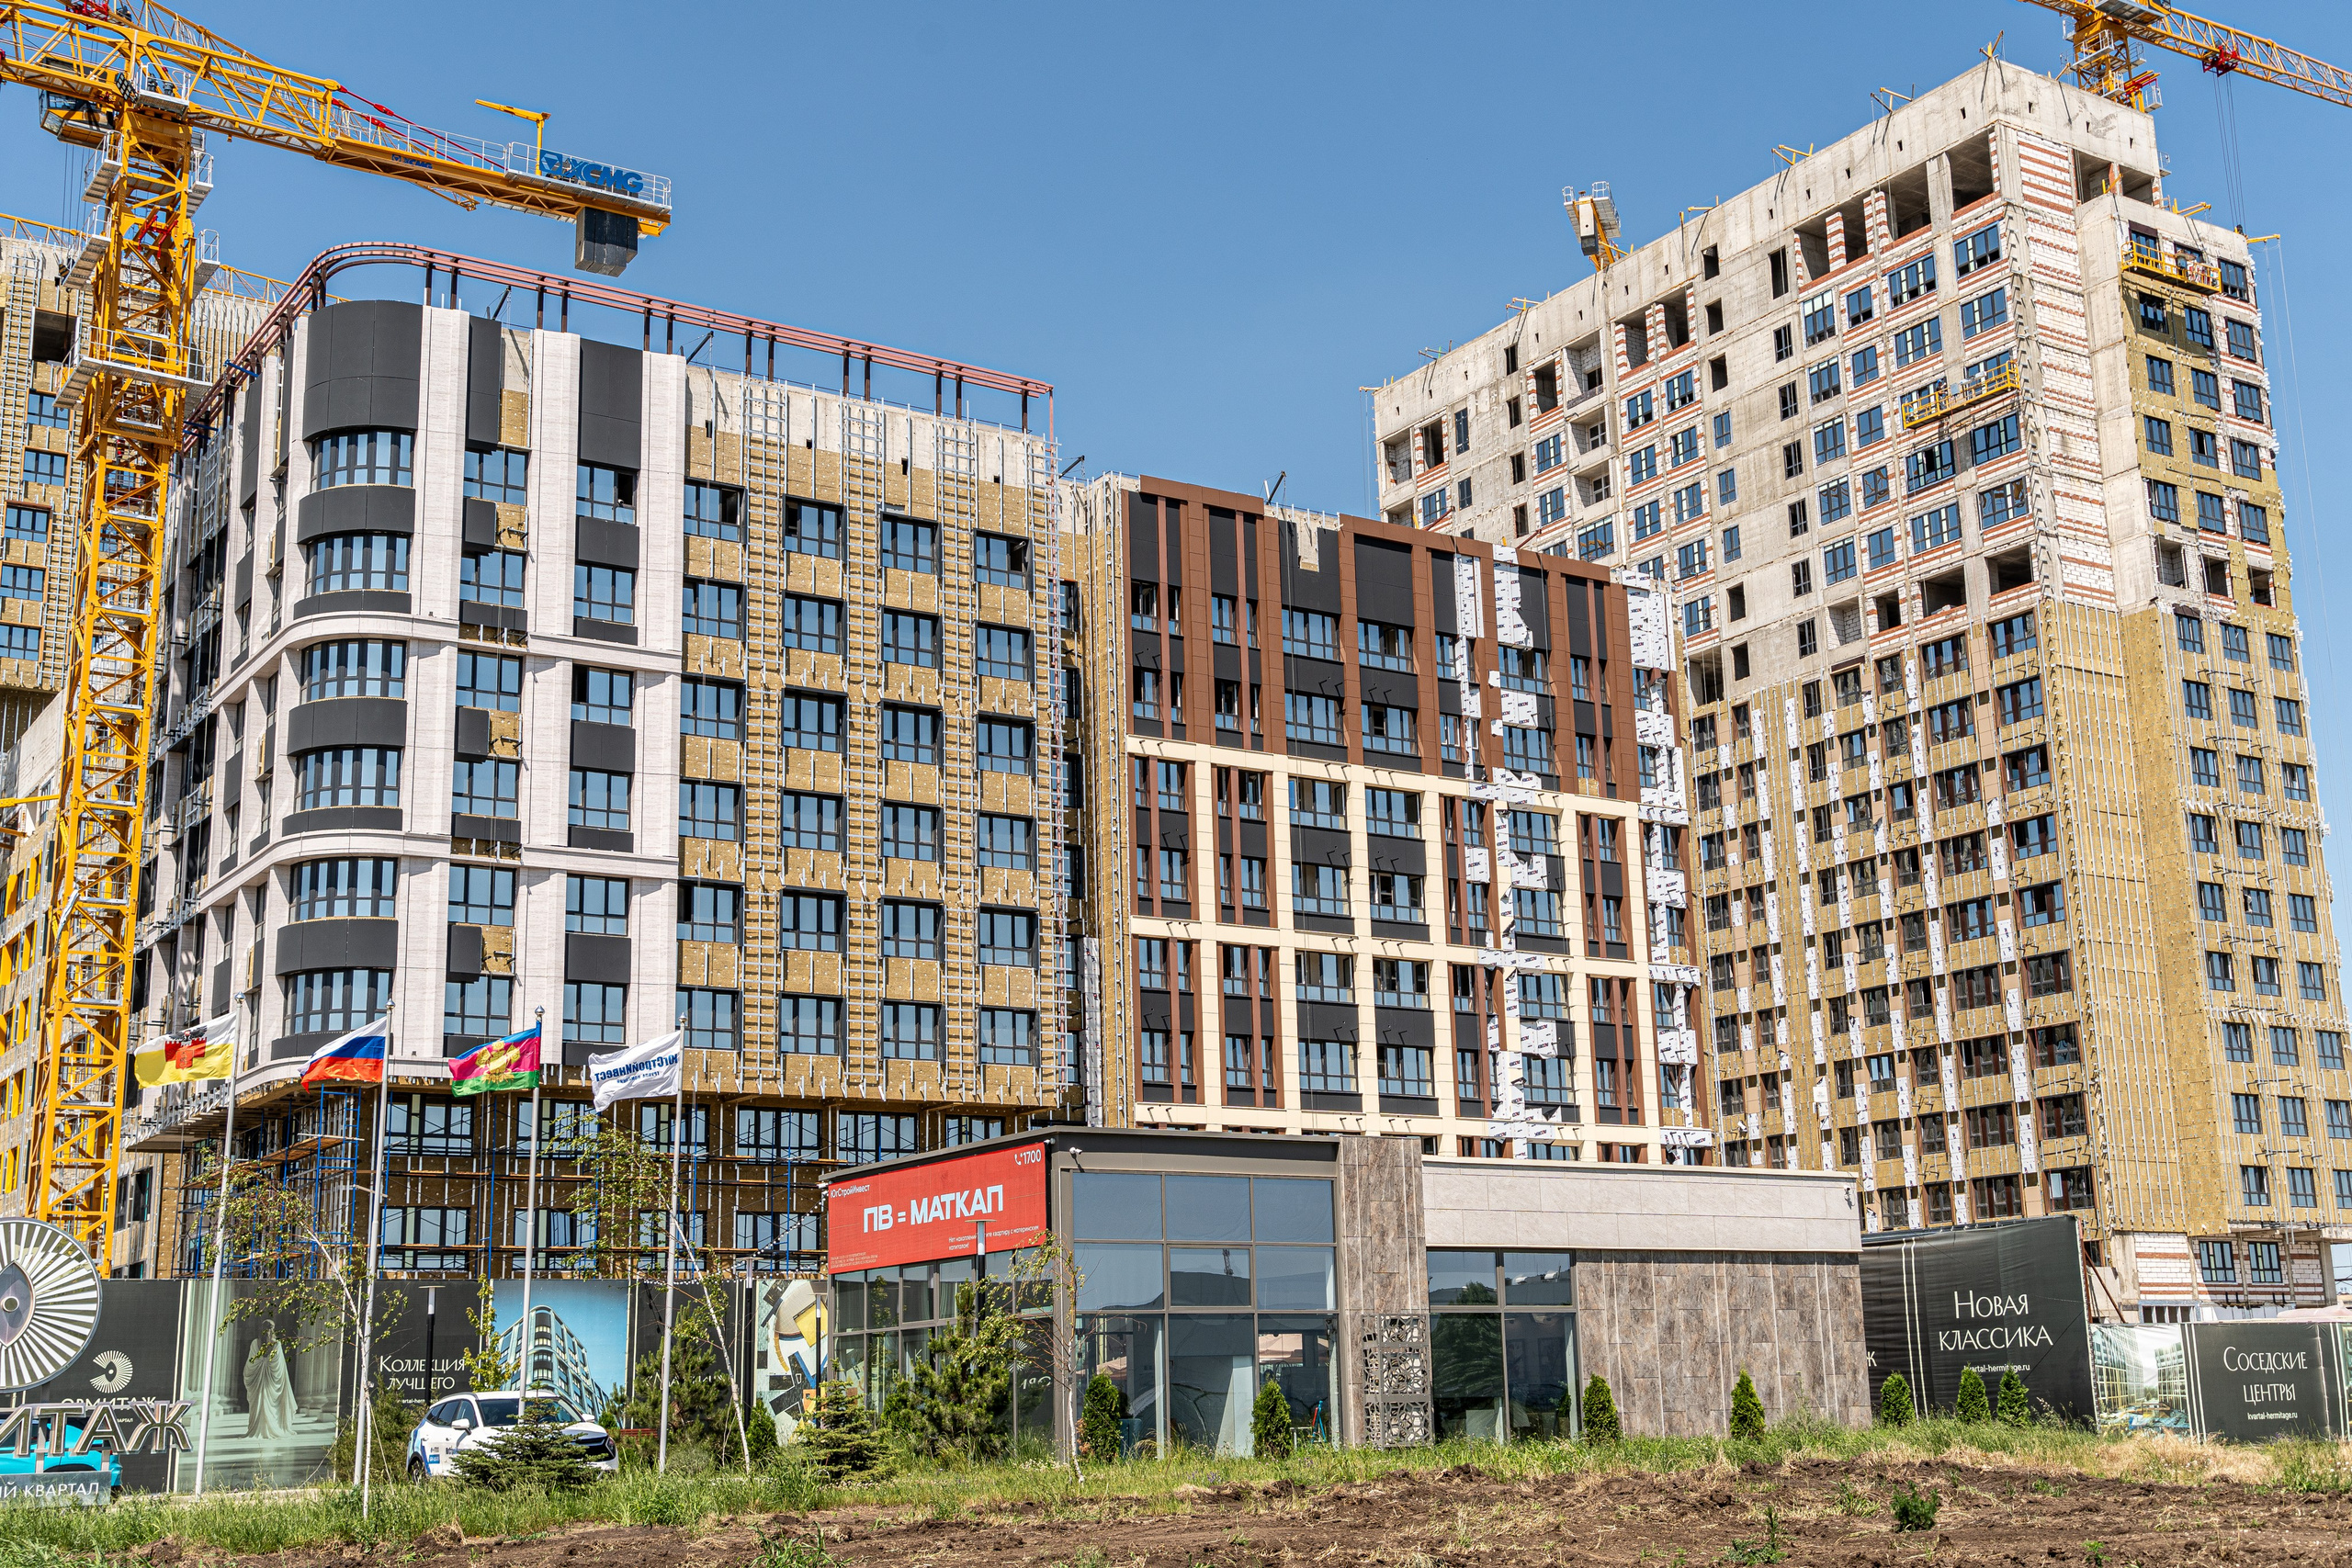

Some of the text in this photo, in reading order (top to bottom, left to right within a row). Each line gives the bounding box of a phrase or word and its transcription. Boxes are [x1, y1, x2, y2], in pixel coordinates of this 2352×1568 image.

[562, 158, 643, 193] XCMG
[831, 1184, 870, 1198] ЮгСтройИнвест
[864, 1204, 893, 1234] ПВ
[910, 1184, 1003, 1225] МАТКАП
[2247, 1412, 2298, 1420] kvartal-hermitage.ru
[24, 1482, 99, 1497] КВАРТАЛ
